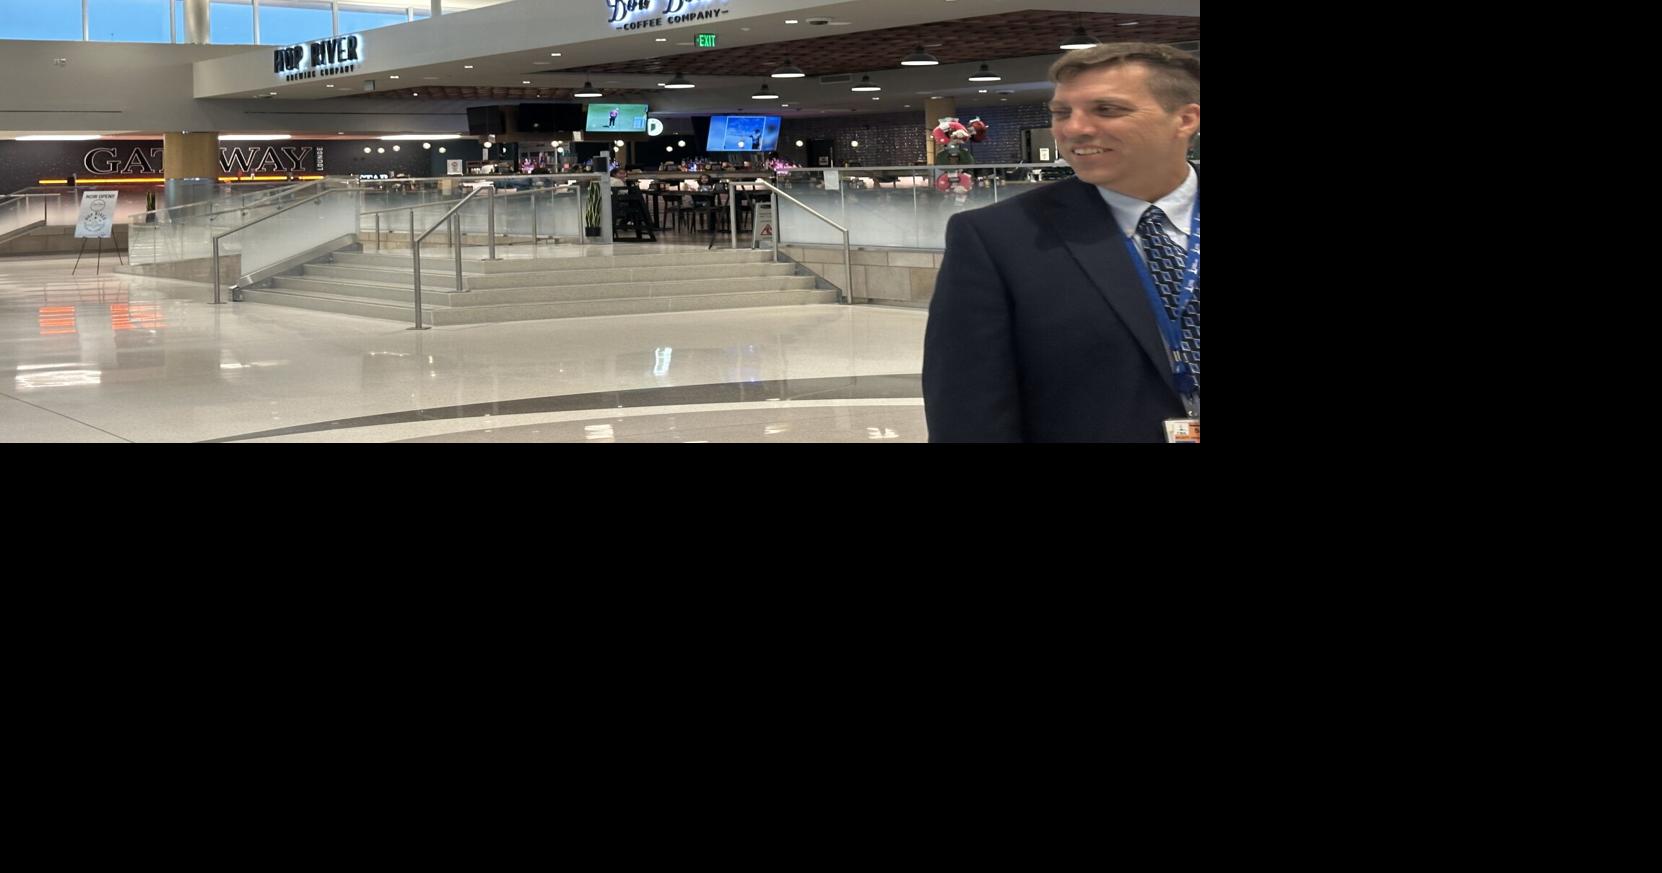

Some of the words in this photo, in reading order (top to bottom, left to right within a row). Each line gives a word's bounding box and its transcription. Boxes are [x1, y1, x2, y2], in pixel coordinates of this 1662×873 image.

[699, 34, 716, 47] EXIT
[273, 45, 304, 73] HOP
[311, 35, 358, 67] RIVER
